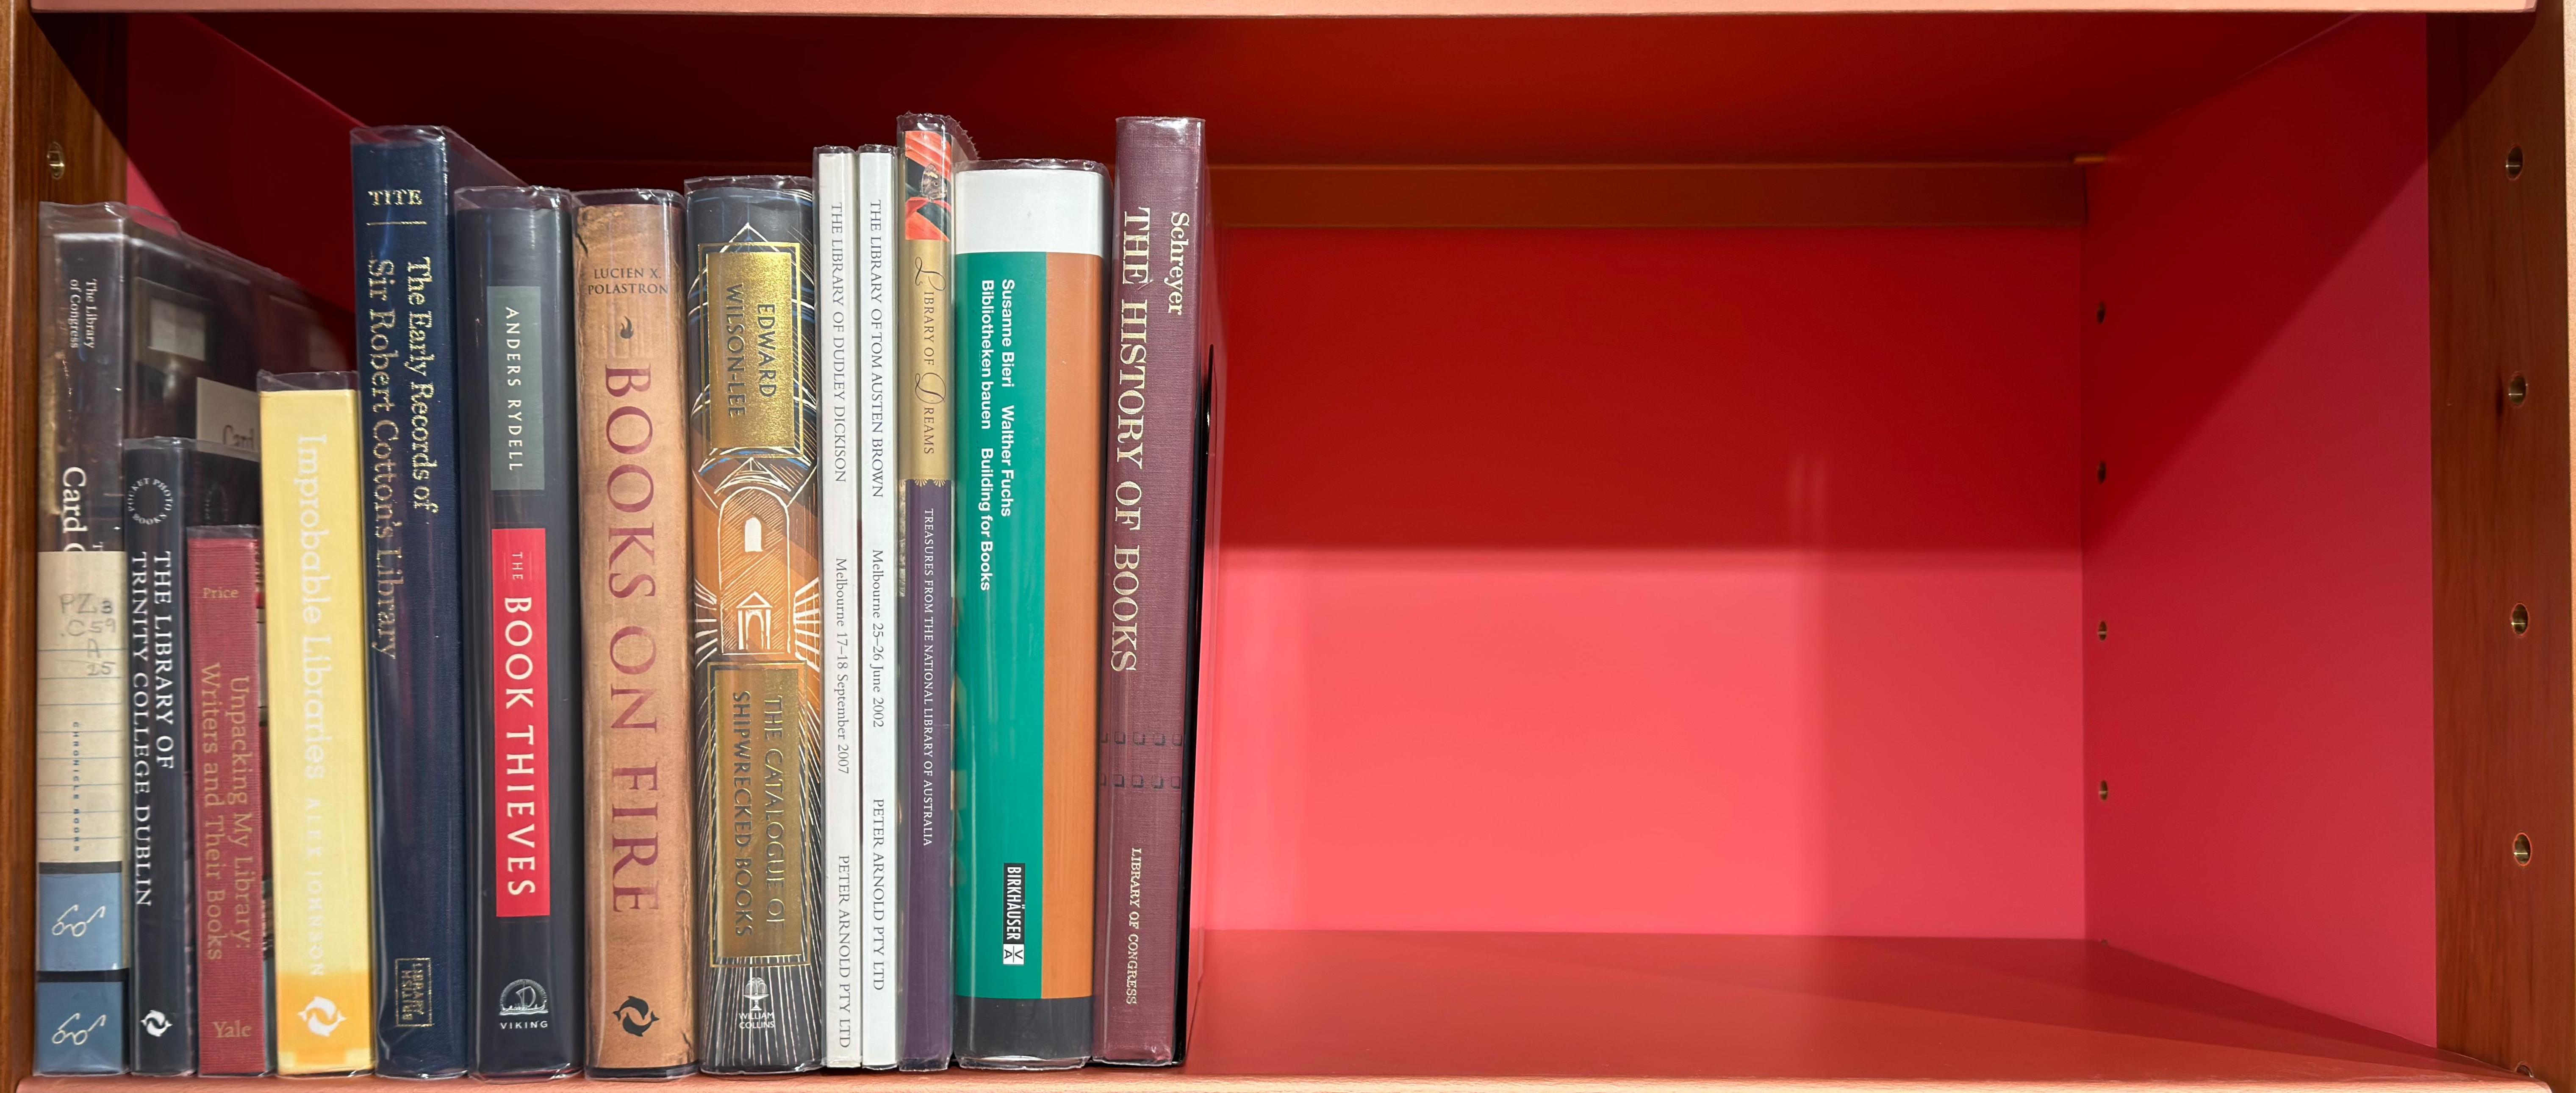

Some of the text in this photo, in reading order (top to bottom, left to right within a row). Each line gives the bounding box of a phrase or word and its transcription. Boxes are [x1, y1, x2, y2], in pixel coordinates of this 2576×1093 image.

[368, 189, 422, 205] TITE
[1164, 212, 1189, 315] Schreyer
[68, 279, 79, 349] of Congress
[84, 278, 97, 349] The Library
[369, 260, 396, 301] Sir
[588, 283, 668, 295] POLASTRON
[594, 268, 661, 279] LUCIEN X.
[369, 309, 399, 412] Robert
[403, 257, 439, 514] The Early Records of
[505, 307, 522, 470] ANDERS RYDELL
[726, 284, 746, 418] WILSON-LEE
[757, 304, 776, 397] EDWARD
[831, 202, 846, 482] THE LIBRARY OF DUDLEY DICKISON
[870, 200, 883, 497] THE LIBRARY OF TOM AUSTEN BROWN
[915, 257, 946, 454] LIBRARY OF DREAMS
[1001, 279, 1015, 517] Susanne Bieri Walther Fuchs
[63, 467, 88, 533] Card
[978, 280, 994, 590] Bibliotheken bauen Building for Books
[1111, 207, 1151, 672] THE HISTORY OF BOOKS
[202, 587, 238, 598] Price
[371, 549, 403, 659] Library
[605, 364, 658, 913] BOOKS ON FIRE
[836, 558, 847, 626] Melbourne
[873, 550, 883, 619] Melbourne
[154, 551, 173, 769] THE LIBRARY OF
[294, 434, 332, 976] Improbable Libraries ALEX JOHNSON
[505, 552, 535, 896] THE BOOK THIEVES
[834, 674, 848, 739] September
[870, 664, 884, 692] June
[873, 697, 884, 728] 2002
[924, 508, 933, 846] TREASURES FROM THE NATIONAL LIBRARY OF AUSTRALIA
[132, 552, 150, 906] TRINITY COLLEGE DUBLIN
[838, 743, 848, 774] 2007
[201, 663, 225, 960] Writers and Their Books
[226, 676, 252, 948] Unpacking My Library:
[732, 691, 754, 937] SHIPWRECKED BOOKS
[764, 696, 785, 930] THE CATALOGUE OF
[839, 855, 850, 1048] PETER ARNOLD PTY LTD
[873, 799, 884, 990] PETER ARNOLD PTY LTD
[1007, 867, 1025, 941] BIRKHÄUSER
[1126, 848, 1141, 1004] LIBRARY OF CONGRESS
[213, 1022, 252, 1038] Yale
[499, 1021, 548, 1029] VIKING
